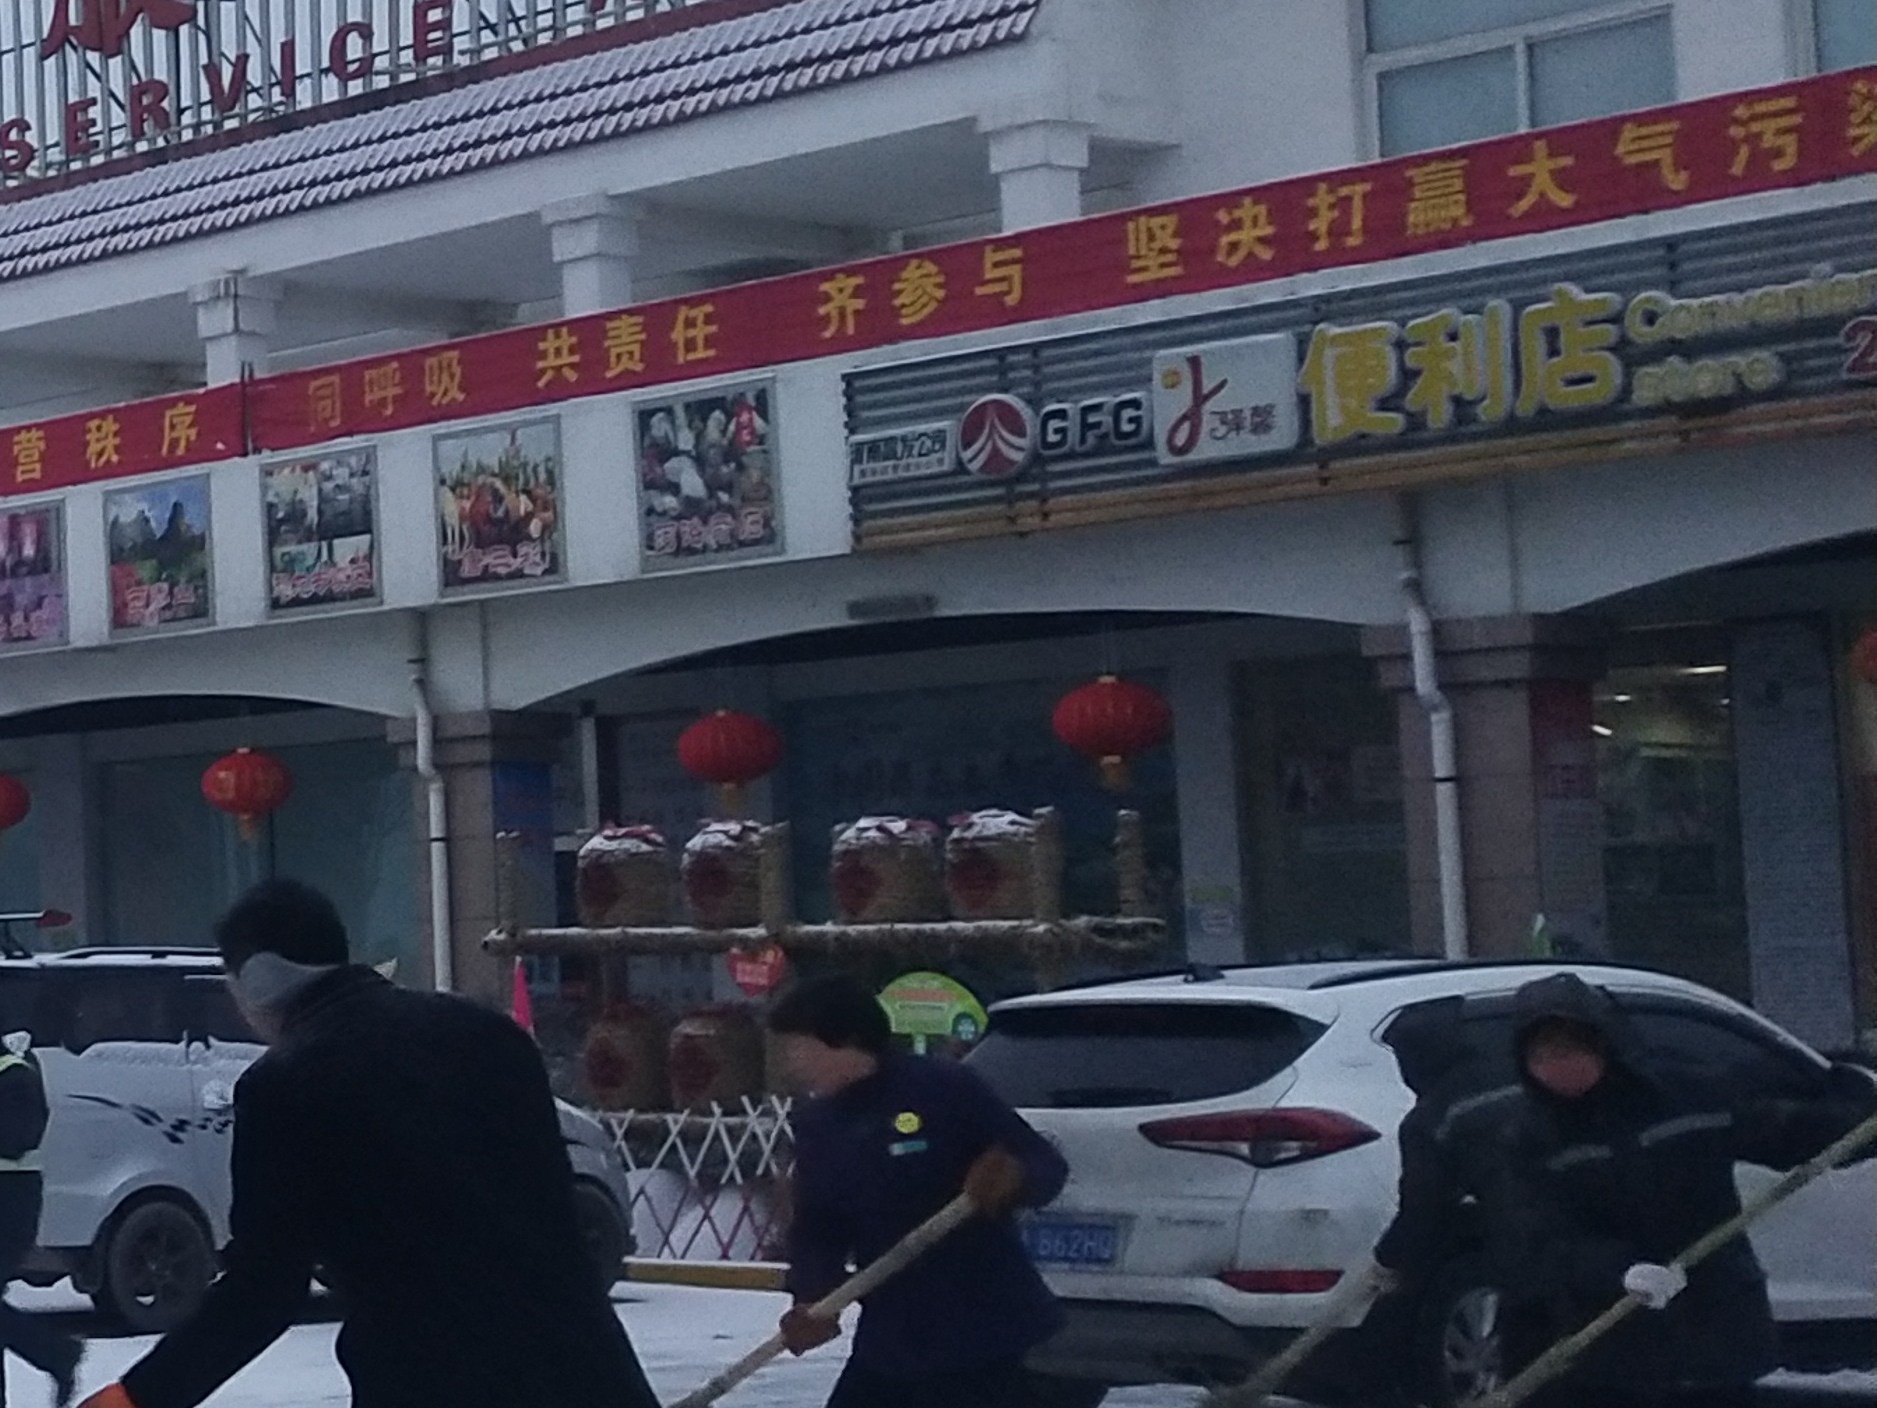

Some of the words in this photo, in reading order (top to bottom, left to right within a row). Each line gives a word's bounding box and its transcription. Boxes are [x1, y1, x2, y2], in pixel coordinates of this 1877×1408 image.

[307, 349, 466, 434] 同呼吸
[536, 303, 719, 386] 共责任
[818, 246, 1026, 339] 齐参与
[1298, 282, 1625, 444] 便利店
[1040, 394, 1144, 451] GFG
